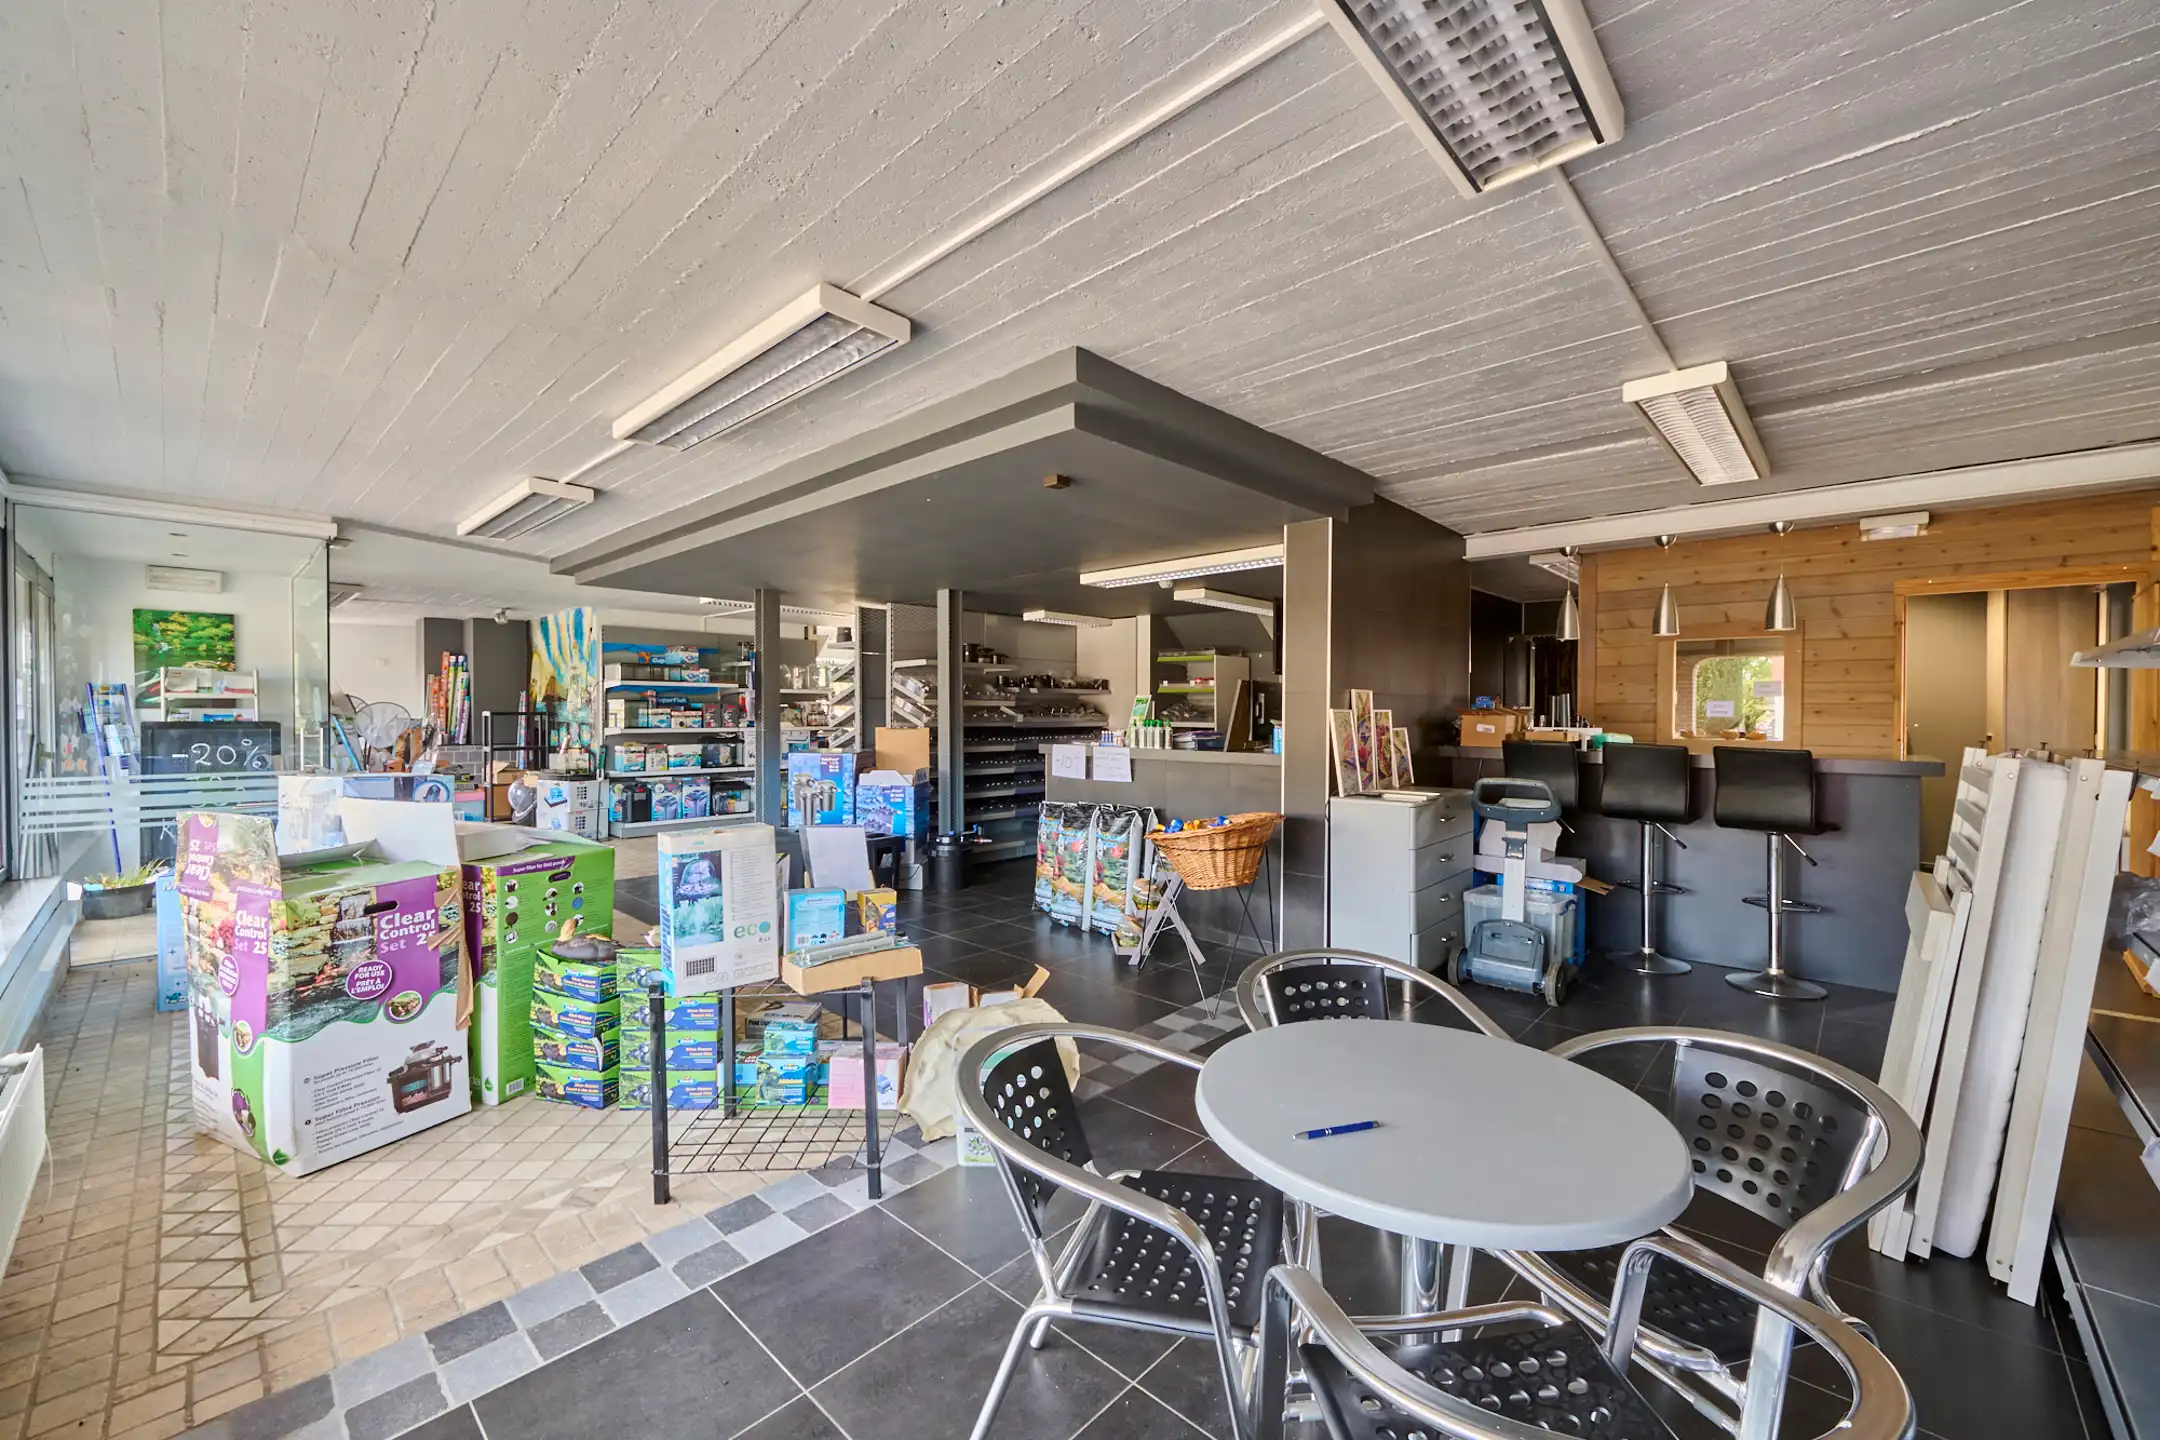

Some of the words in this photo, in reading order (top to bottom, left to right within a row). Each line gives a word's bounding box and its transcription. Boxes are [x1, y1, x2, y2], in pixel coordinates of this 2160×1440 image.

[171, 738, 265, 768] -20%
[462, 879, 481, 891] ear
[469, 901, 481, 913] 25
[236, 909, 268, 931] Clear
[379, 908, 436, 930] Clear
[234, 925, 267, 940] Control
[379, 918, 436, 941] Control
[733, 920, 771, 939] eco
[234, 938, 249, 953] Set
[252, 940, 268, 955] 25
[379, 938, 407, 954] Set
[354, 970, 370, 980] FOR
[370, 969, 386, 978] USE
[358, 964, 384, 974] READY
[313, 1071, 333, 1081] Super
[334, 1060, 362, 1074] Pressure
[314, 1111, 334, 1121] Super
